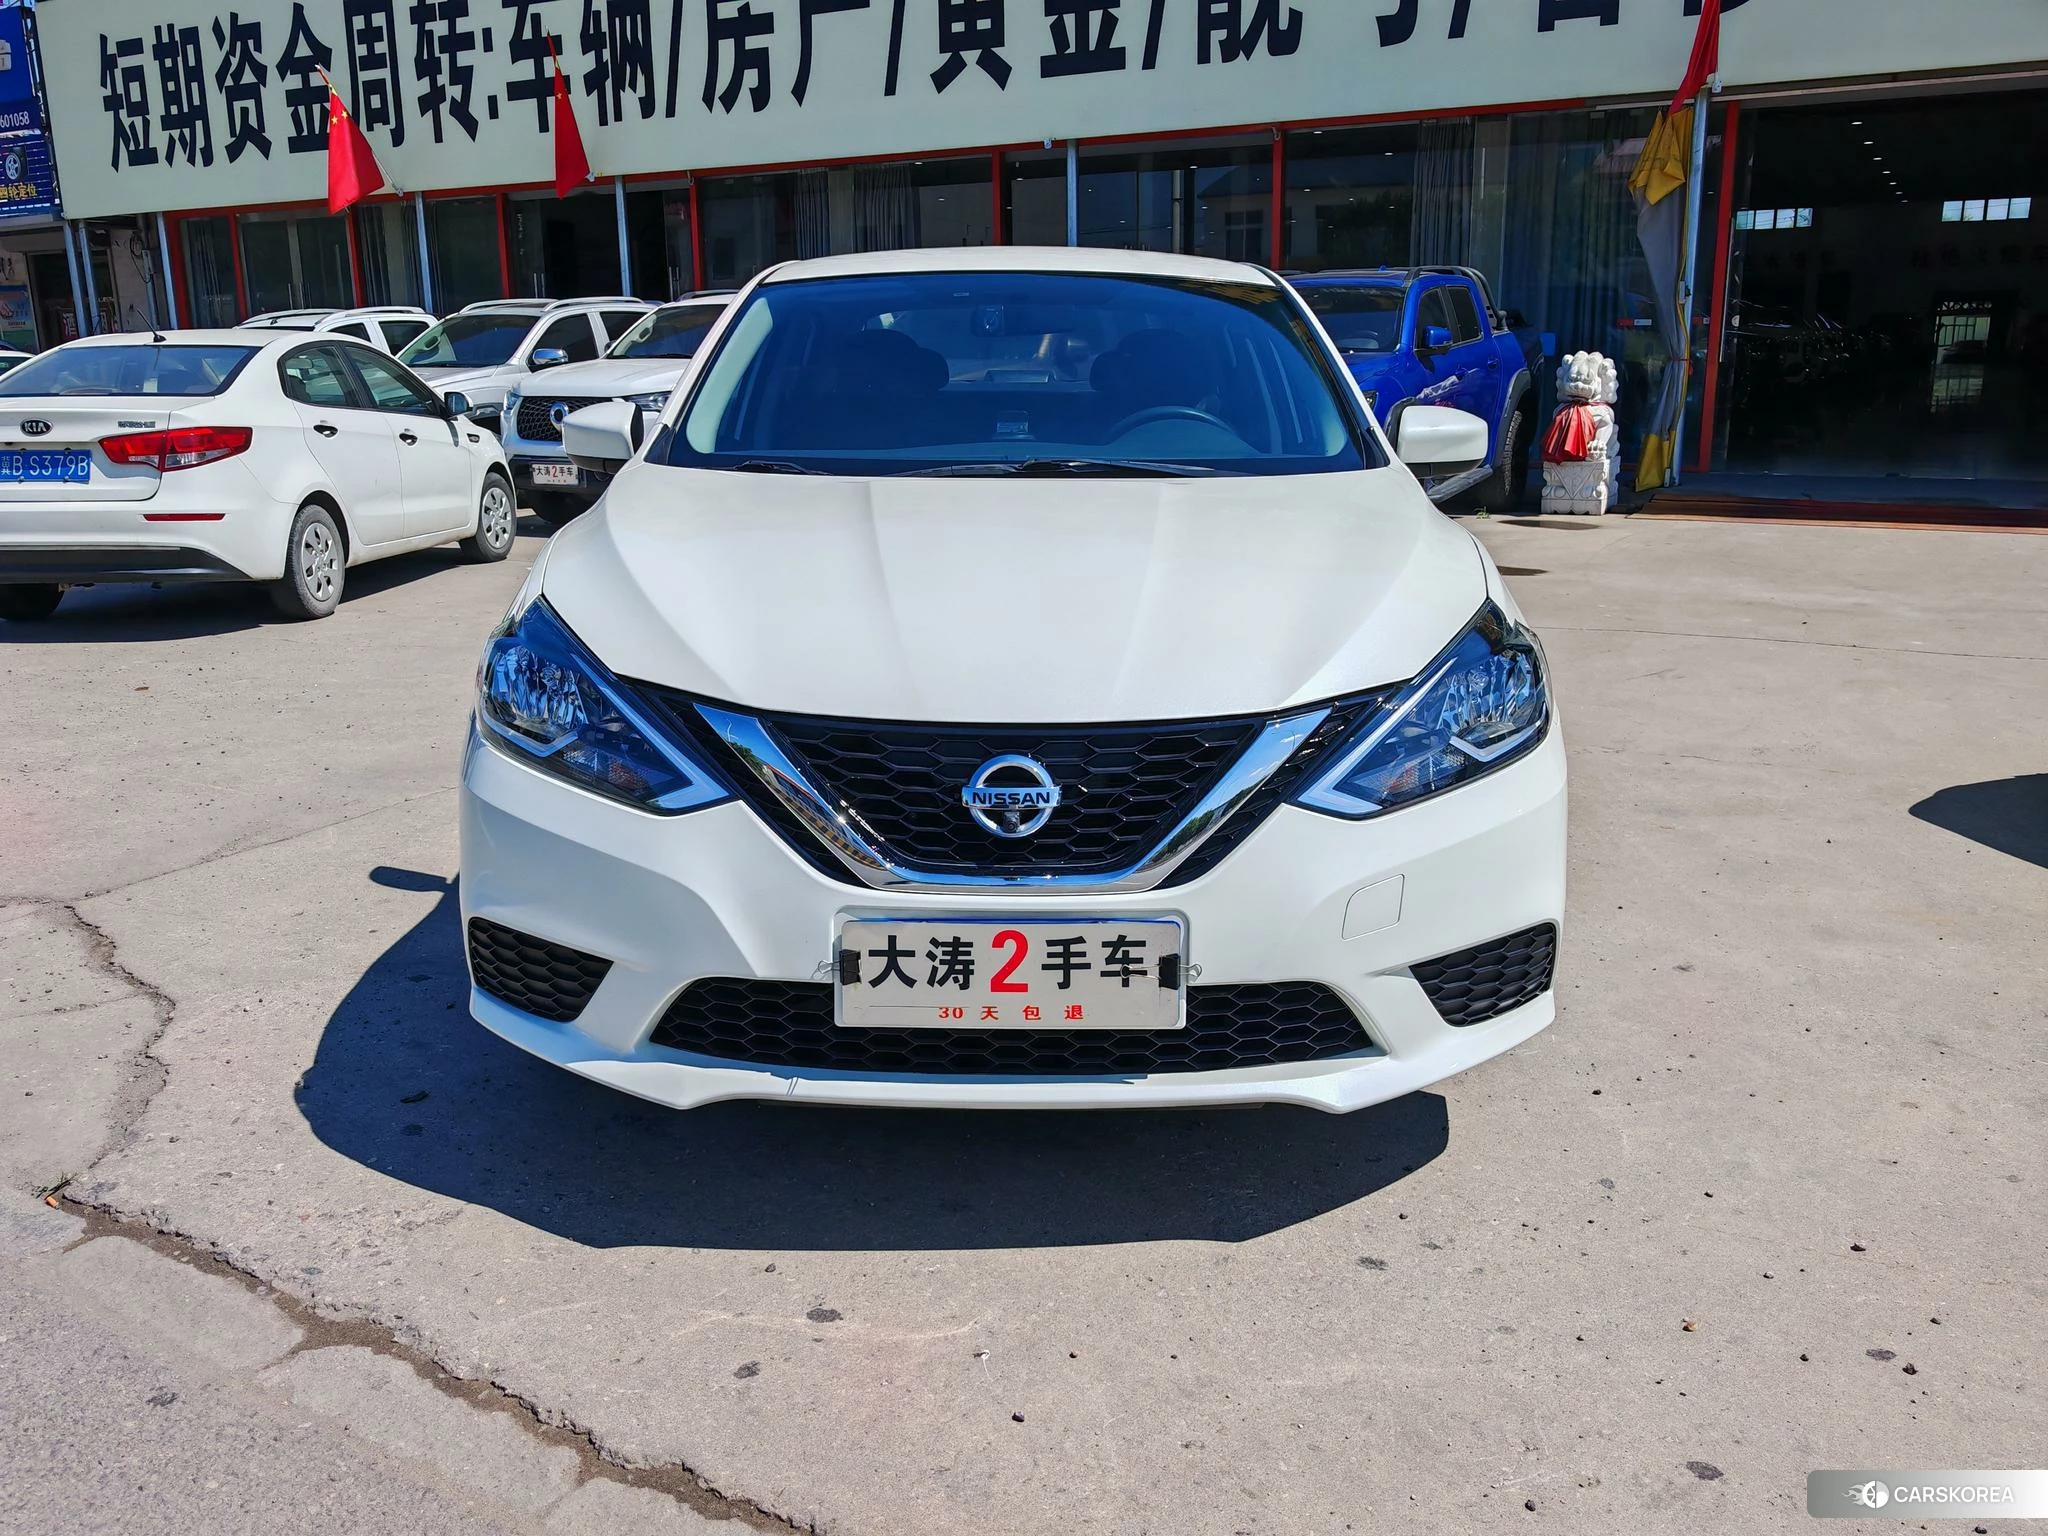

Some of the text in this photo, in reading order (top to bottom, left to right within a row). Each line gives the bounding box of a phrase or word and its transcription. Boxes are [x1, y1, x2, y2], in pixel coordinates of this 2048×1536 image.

[24, 422, 47, 432] KIA
[972, 791, 1050, 805] NISSAN
[868, 930, 1148, 993] 大涛2手车
